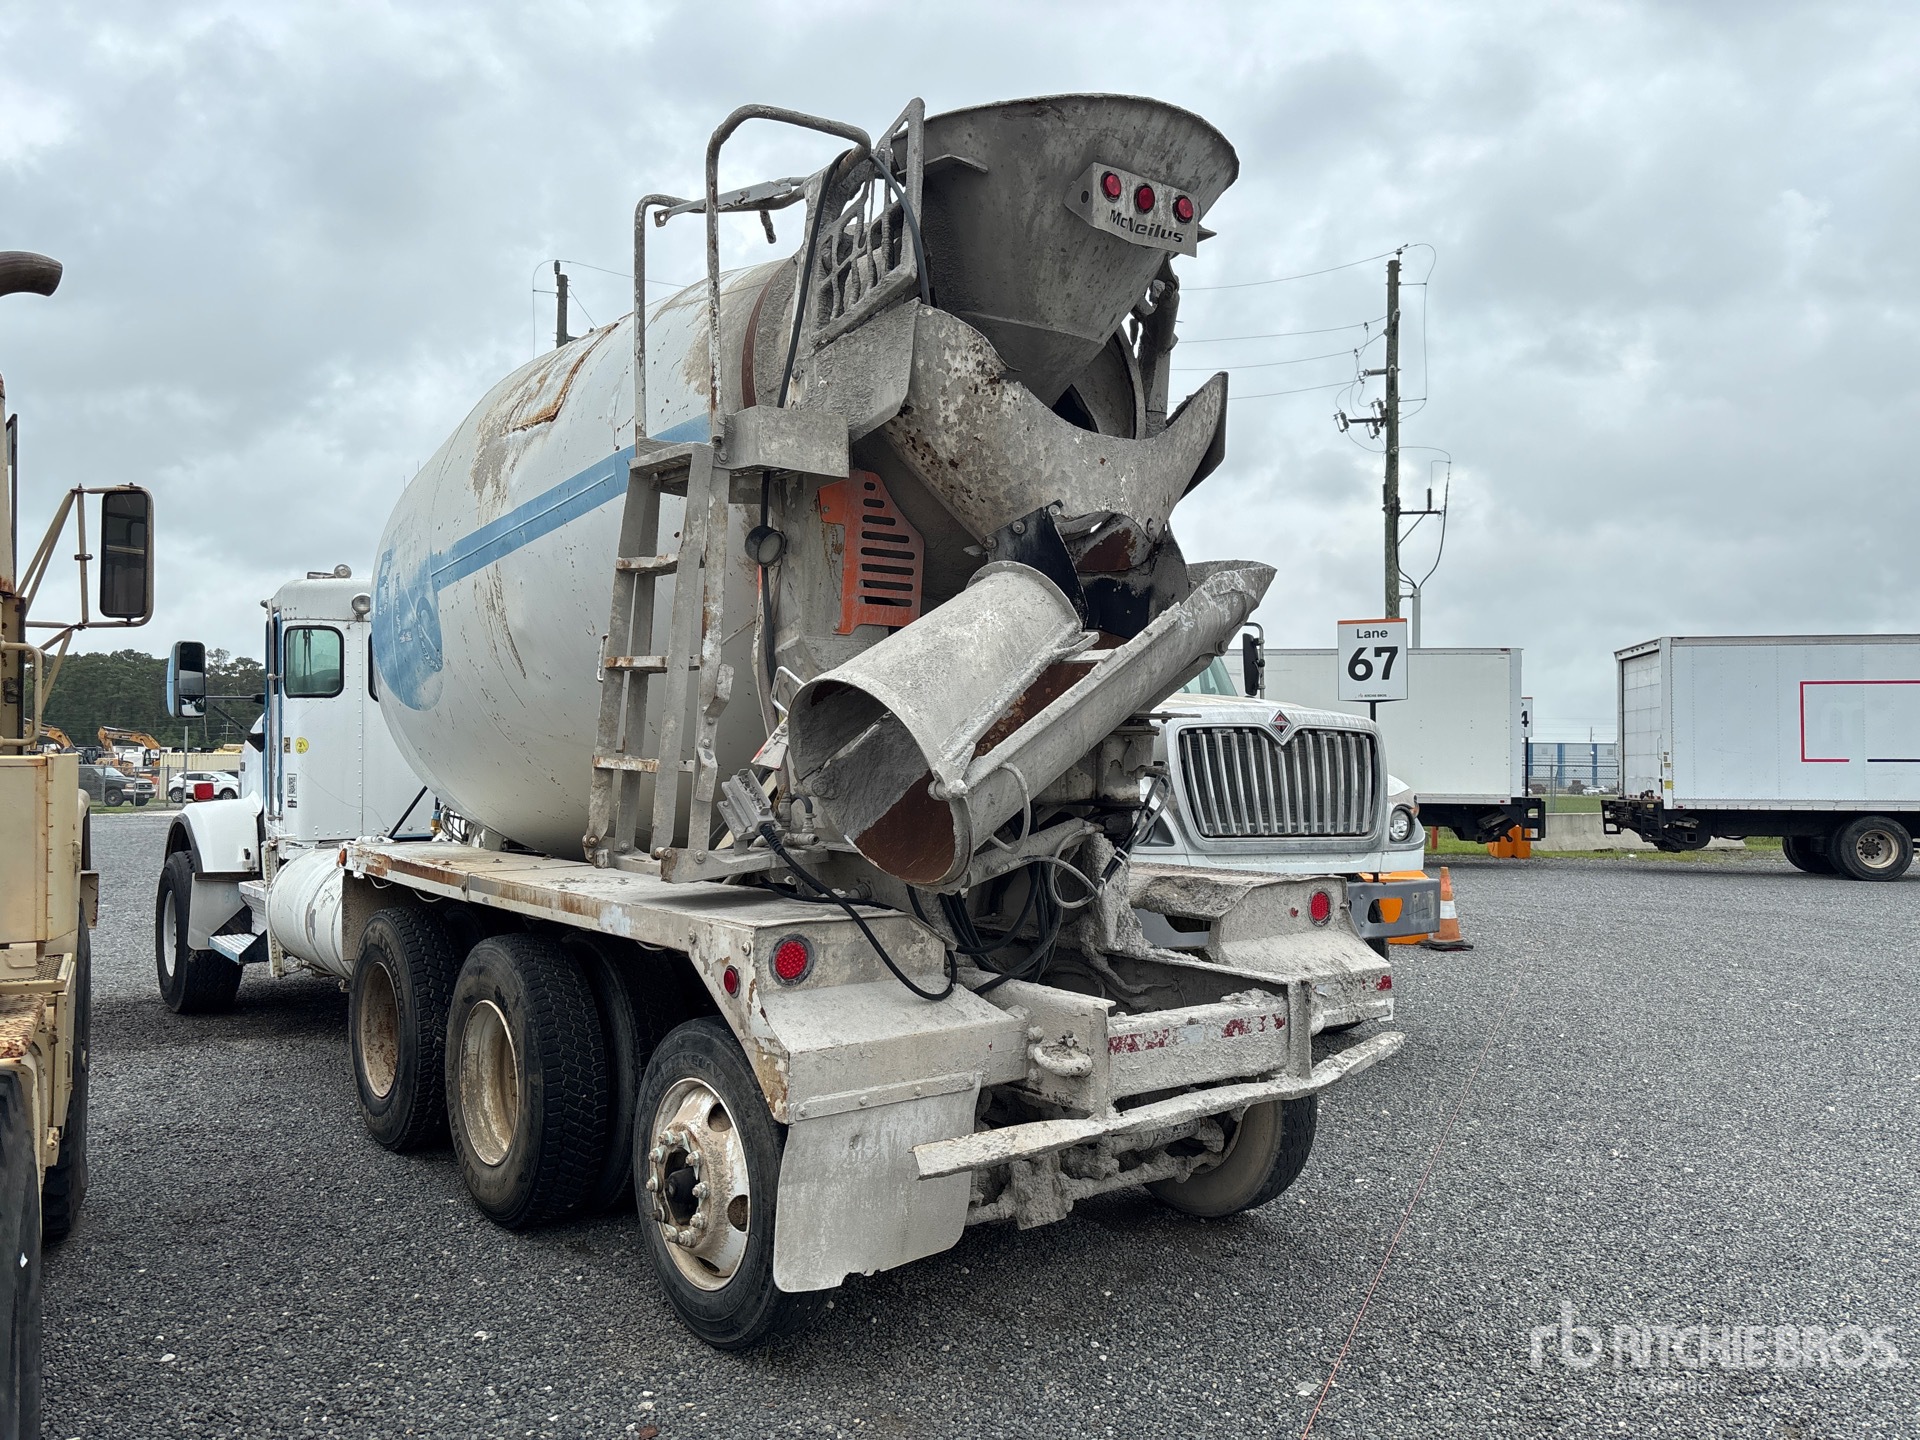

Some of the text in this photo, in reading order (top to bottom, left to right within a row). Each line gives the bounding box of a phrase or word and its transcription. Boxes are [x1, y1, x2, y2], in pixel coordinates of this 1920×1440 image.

[1109, 209, 1184, 243] McNeilus
[1356, 628, 1389, 639] Lane
[1347, 646, 1399, 682] 67
